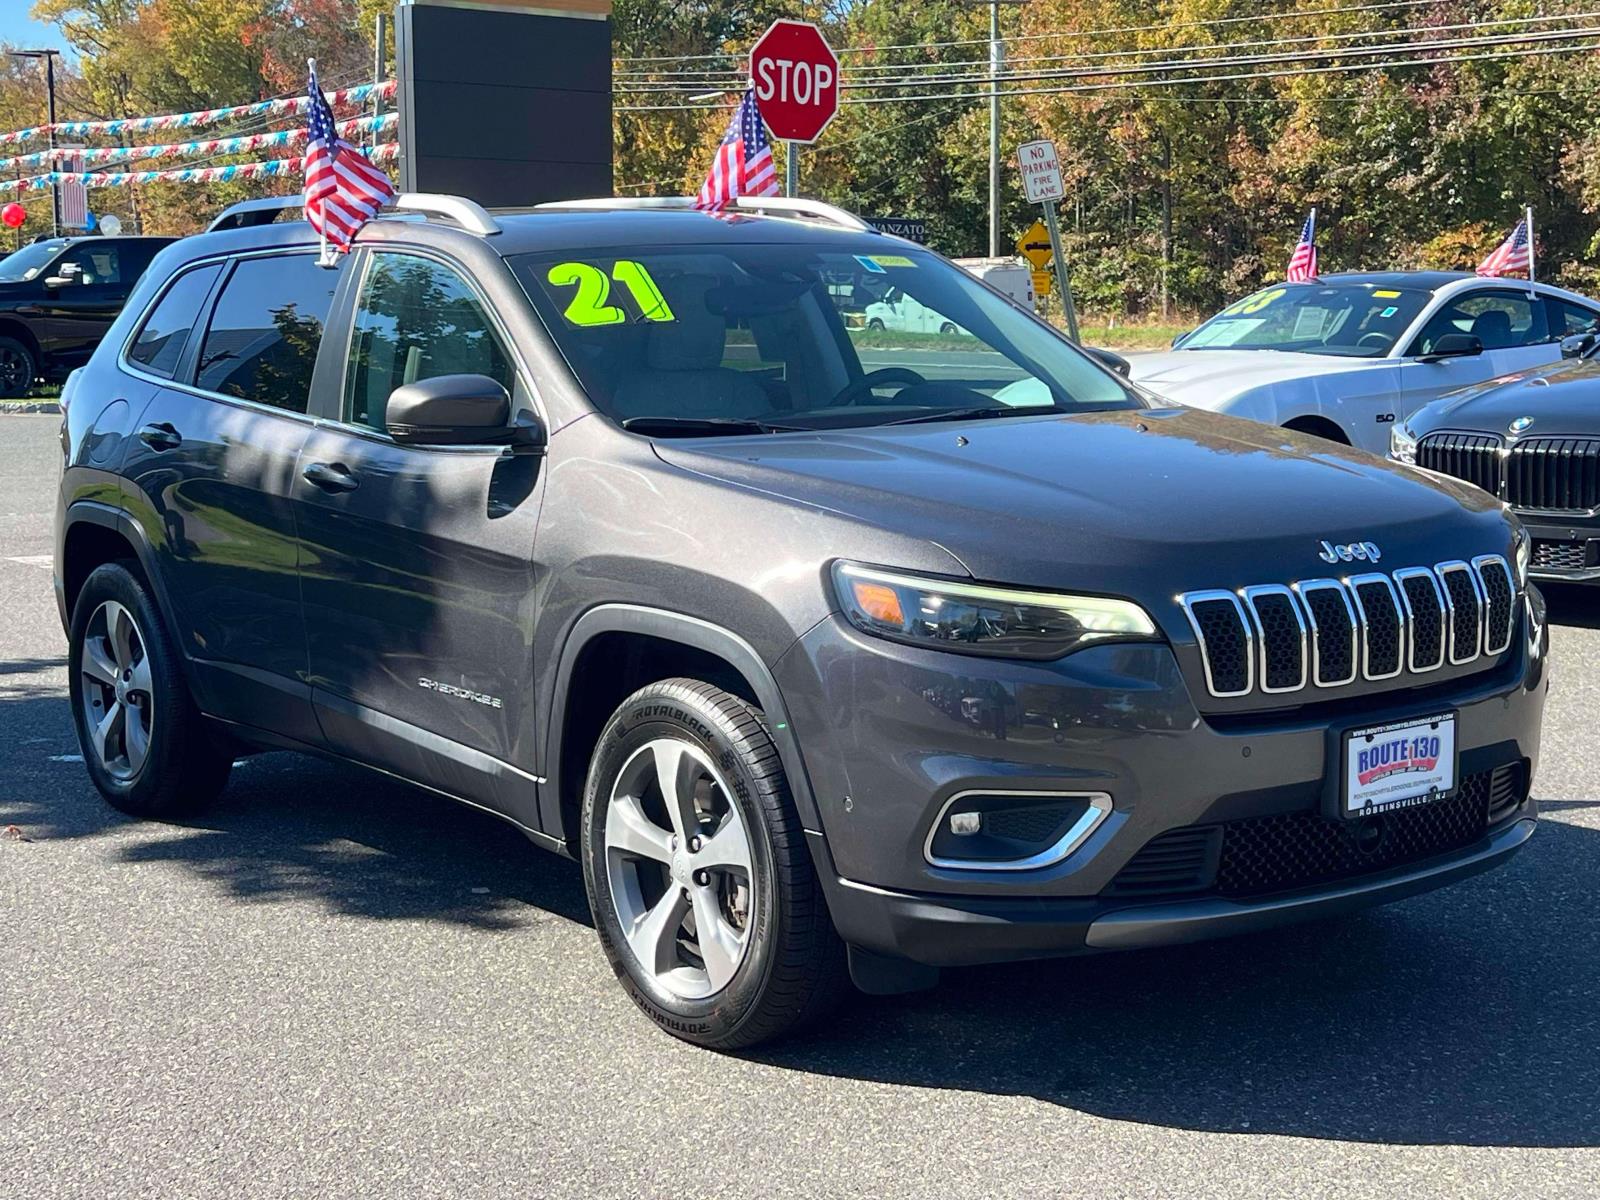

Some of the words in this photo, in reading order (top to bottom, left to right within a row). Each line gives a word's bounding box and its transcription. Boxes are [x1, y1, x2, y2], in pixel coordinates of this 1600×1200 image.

[757, 57, 833, 106] STOP
[1030, 147, 1045, 159] NO
[1023, 160, 1057, 175] PARKING
[1033, 175, 1053, 185] FIRE
[1033, 185, 1057, 197] LANE
[548, 260, 675, 327] 21
[1318, 540, 1381, 564] Jeep
[418, 677, 502, 709] CHEROKEE
[632, 705, 714, 742] ROYALBLACK
[1358, 739, 1408, 773] ROUTE
[1412, 736, 1440, 758] 130
[1435, 791, 1447, 800] NJ
[630, 988, 712, 1034] ROYALBLACK
